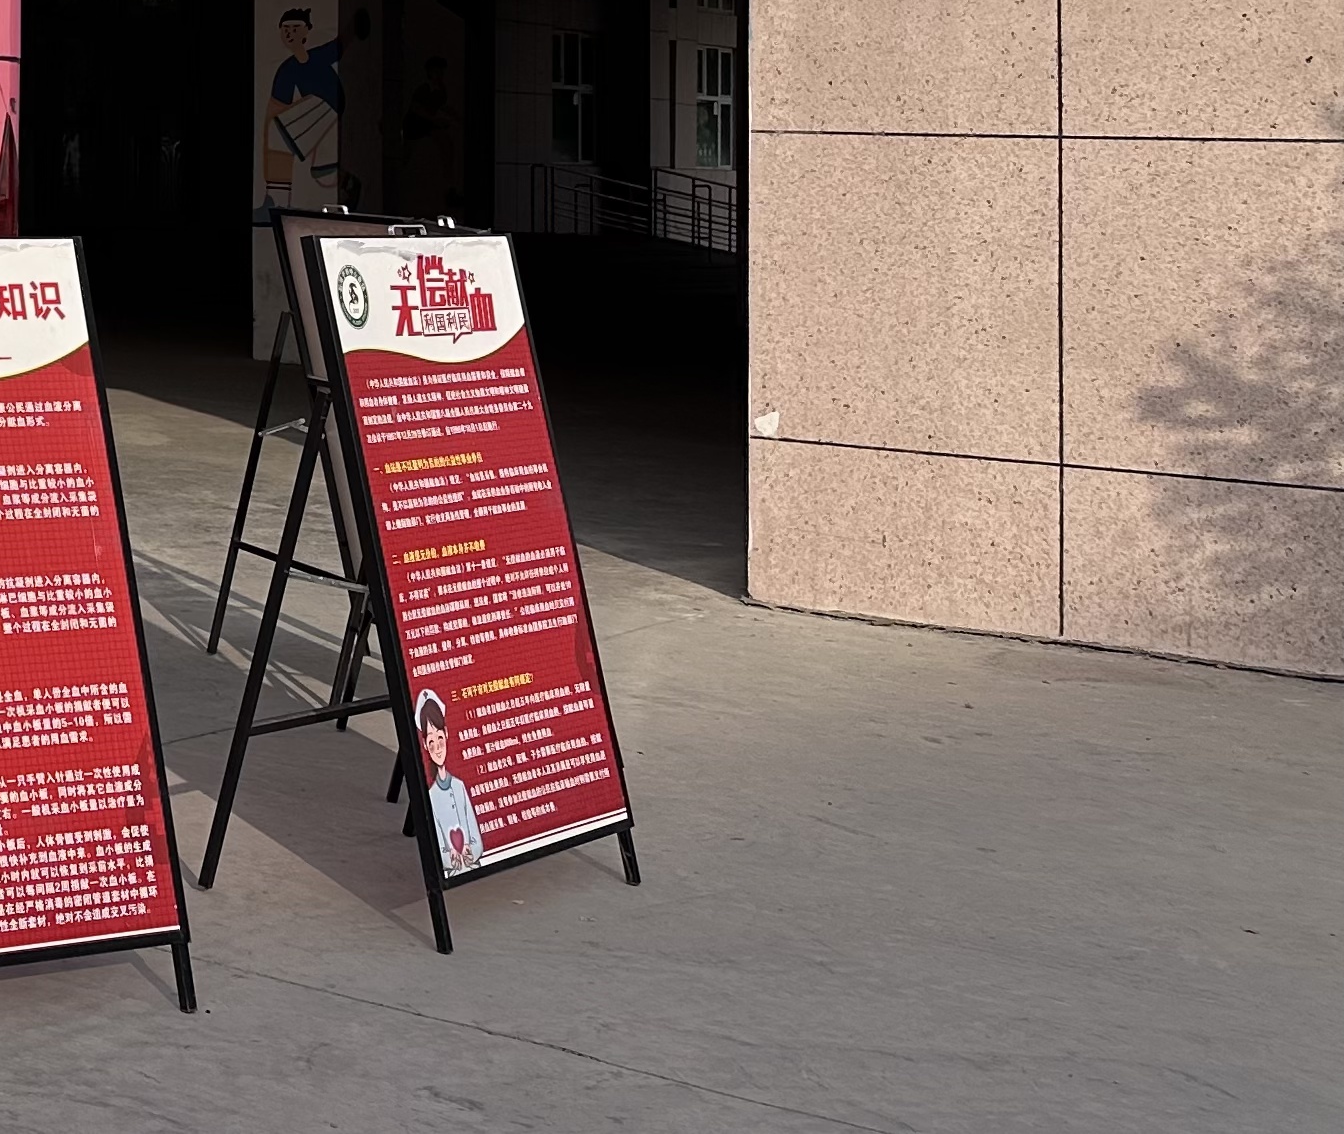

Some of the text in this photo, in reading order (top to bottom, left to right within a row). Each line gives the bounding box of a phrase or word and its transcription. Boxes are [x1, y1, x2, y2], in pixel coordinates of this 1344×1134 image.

[390, 254, 497, 336] 无偿献血
[423, 311, 471, 333] 利国利民
